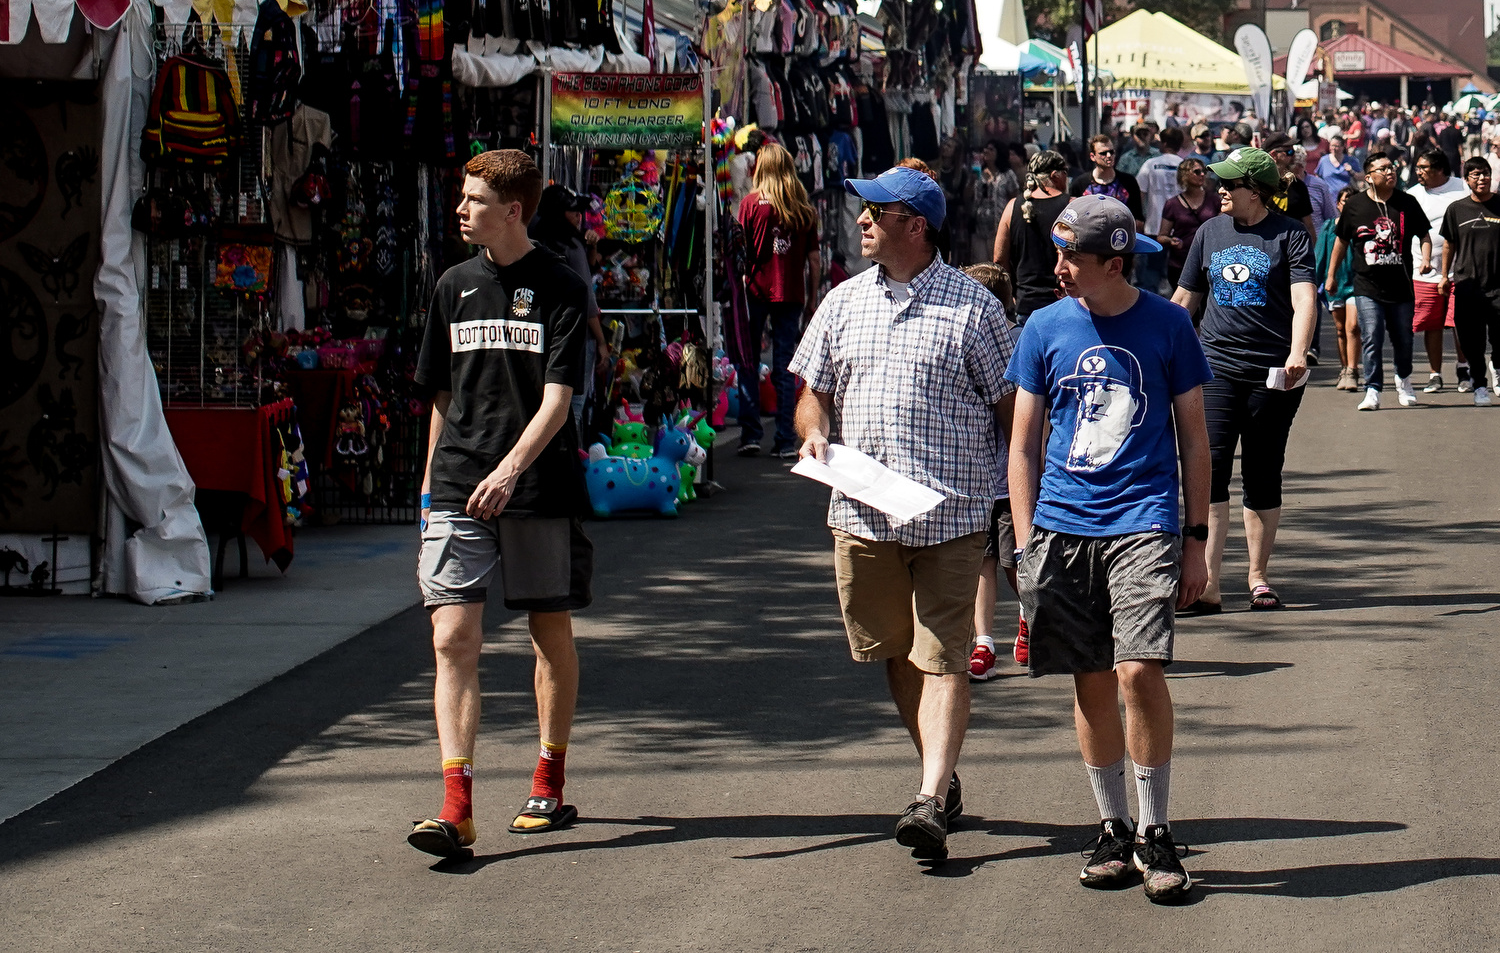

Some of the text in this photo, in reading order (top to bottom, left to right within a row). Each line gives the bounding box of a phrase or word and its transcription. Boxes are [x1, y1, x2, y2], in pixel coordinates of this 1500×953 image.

[558, 75, 698, 92] THE BEST PHONE CORD
[584, 98, 671, 109] 10 FT LONG
[571, 115, 684, 126] QUICK CHARGER
[1228, 266, 1245, 280] Y
[514, 288, 534, 303] CHS
[1086, 358, 1101, 371] Y
